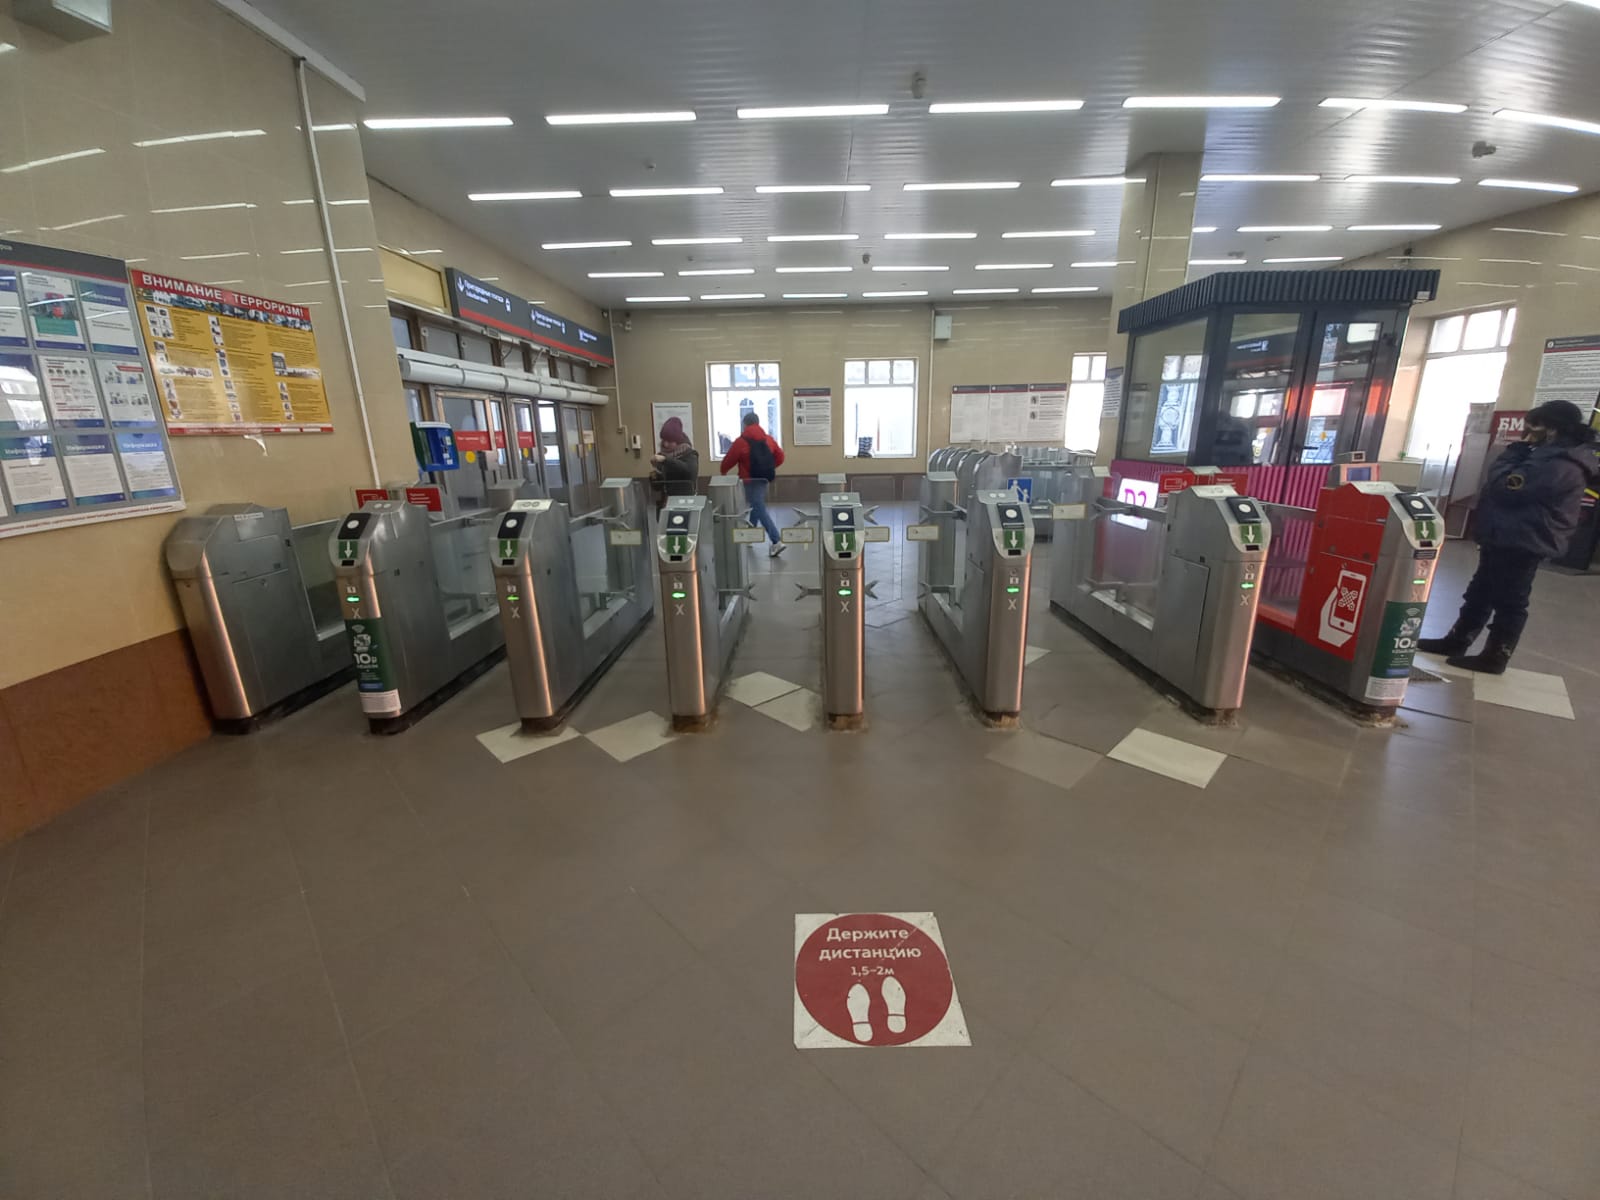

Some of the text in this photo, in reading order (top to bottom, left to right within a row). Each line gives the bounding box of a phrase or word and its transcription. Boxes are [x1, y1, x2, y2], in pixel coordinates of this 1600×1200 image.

[232, 293, 304, 317] ТЕРРОРИЗМ!
[827, 927, 909, 942] Держите
[818, 946, 921, 961] дистанцию
